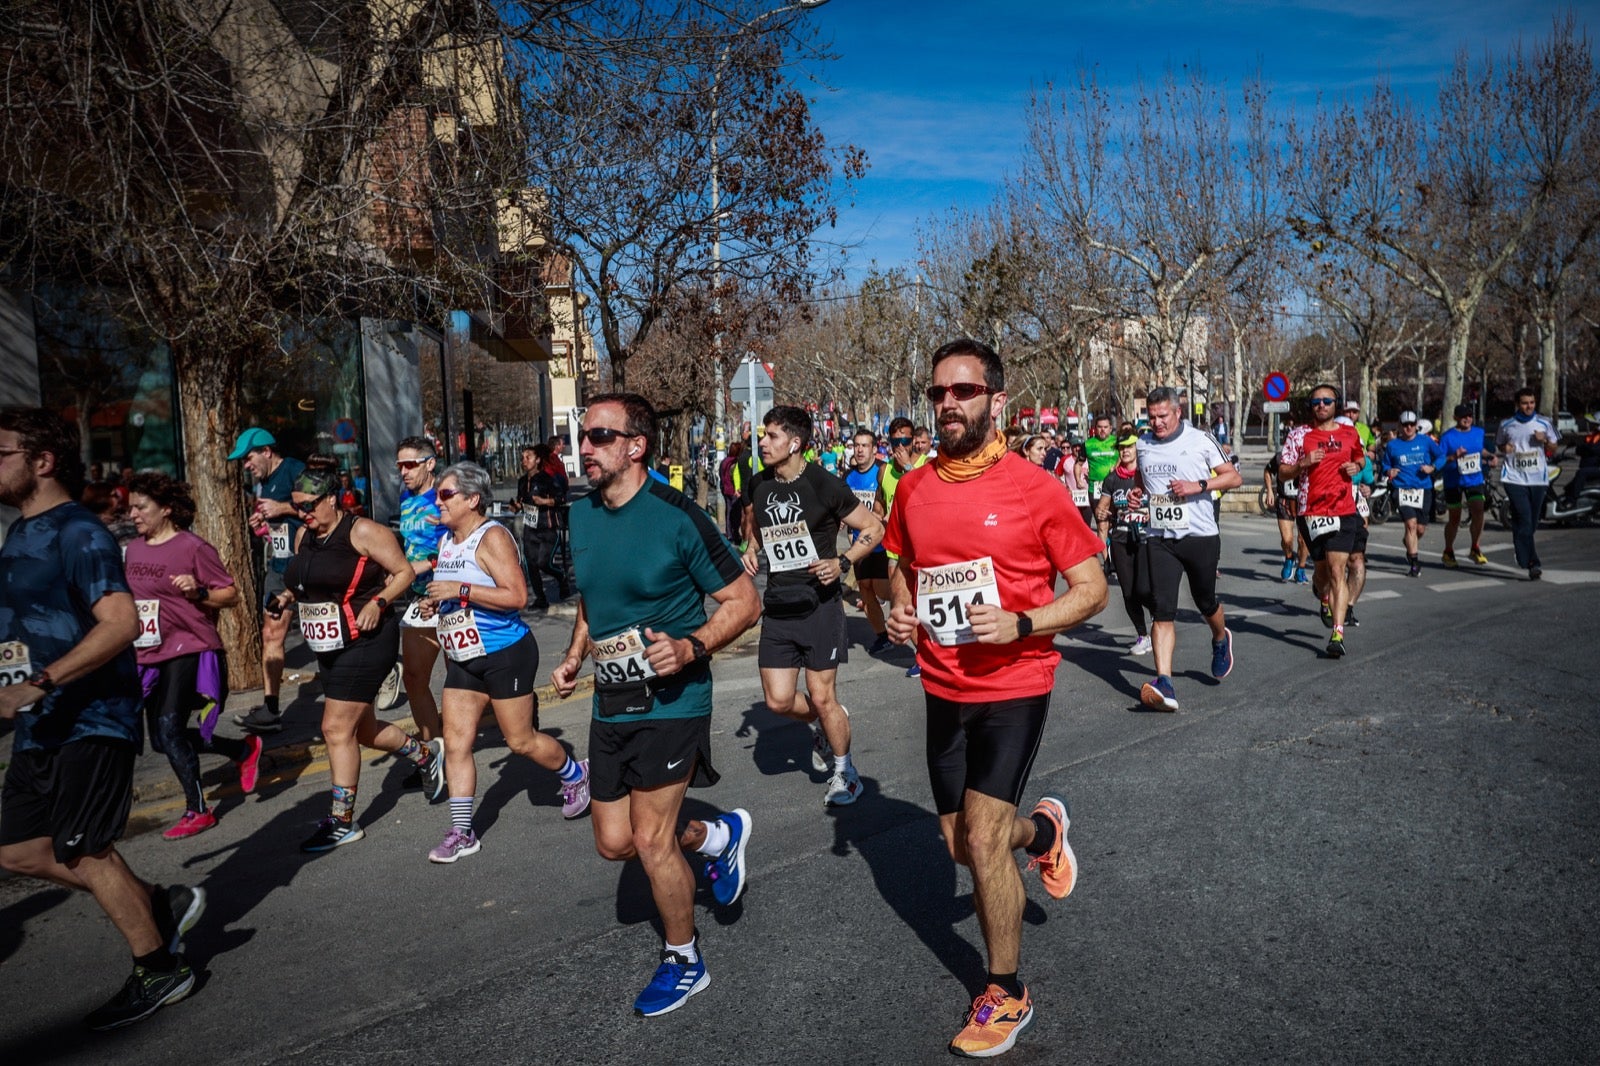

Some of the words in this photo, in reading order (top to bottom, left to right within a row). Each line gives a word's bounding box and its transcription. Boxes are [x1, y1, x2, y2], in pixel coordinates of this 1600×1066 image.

[1465, 461, 1476, 469] 10
[1155, 507, 1184, 521] 649
[769, 526, 799, 538] FONDO
[1311, 517, 1335, 531] 420
[773, 539, 808, 561] 616
[928, 569, 977, 588] FONDO
[302, 621, 340, 641] 2035
[440, 628, 480, 651] 2129
[595, 657, 646, 685] 394
